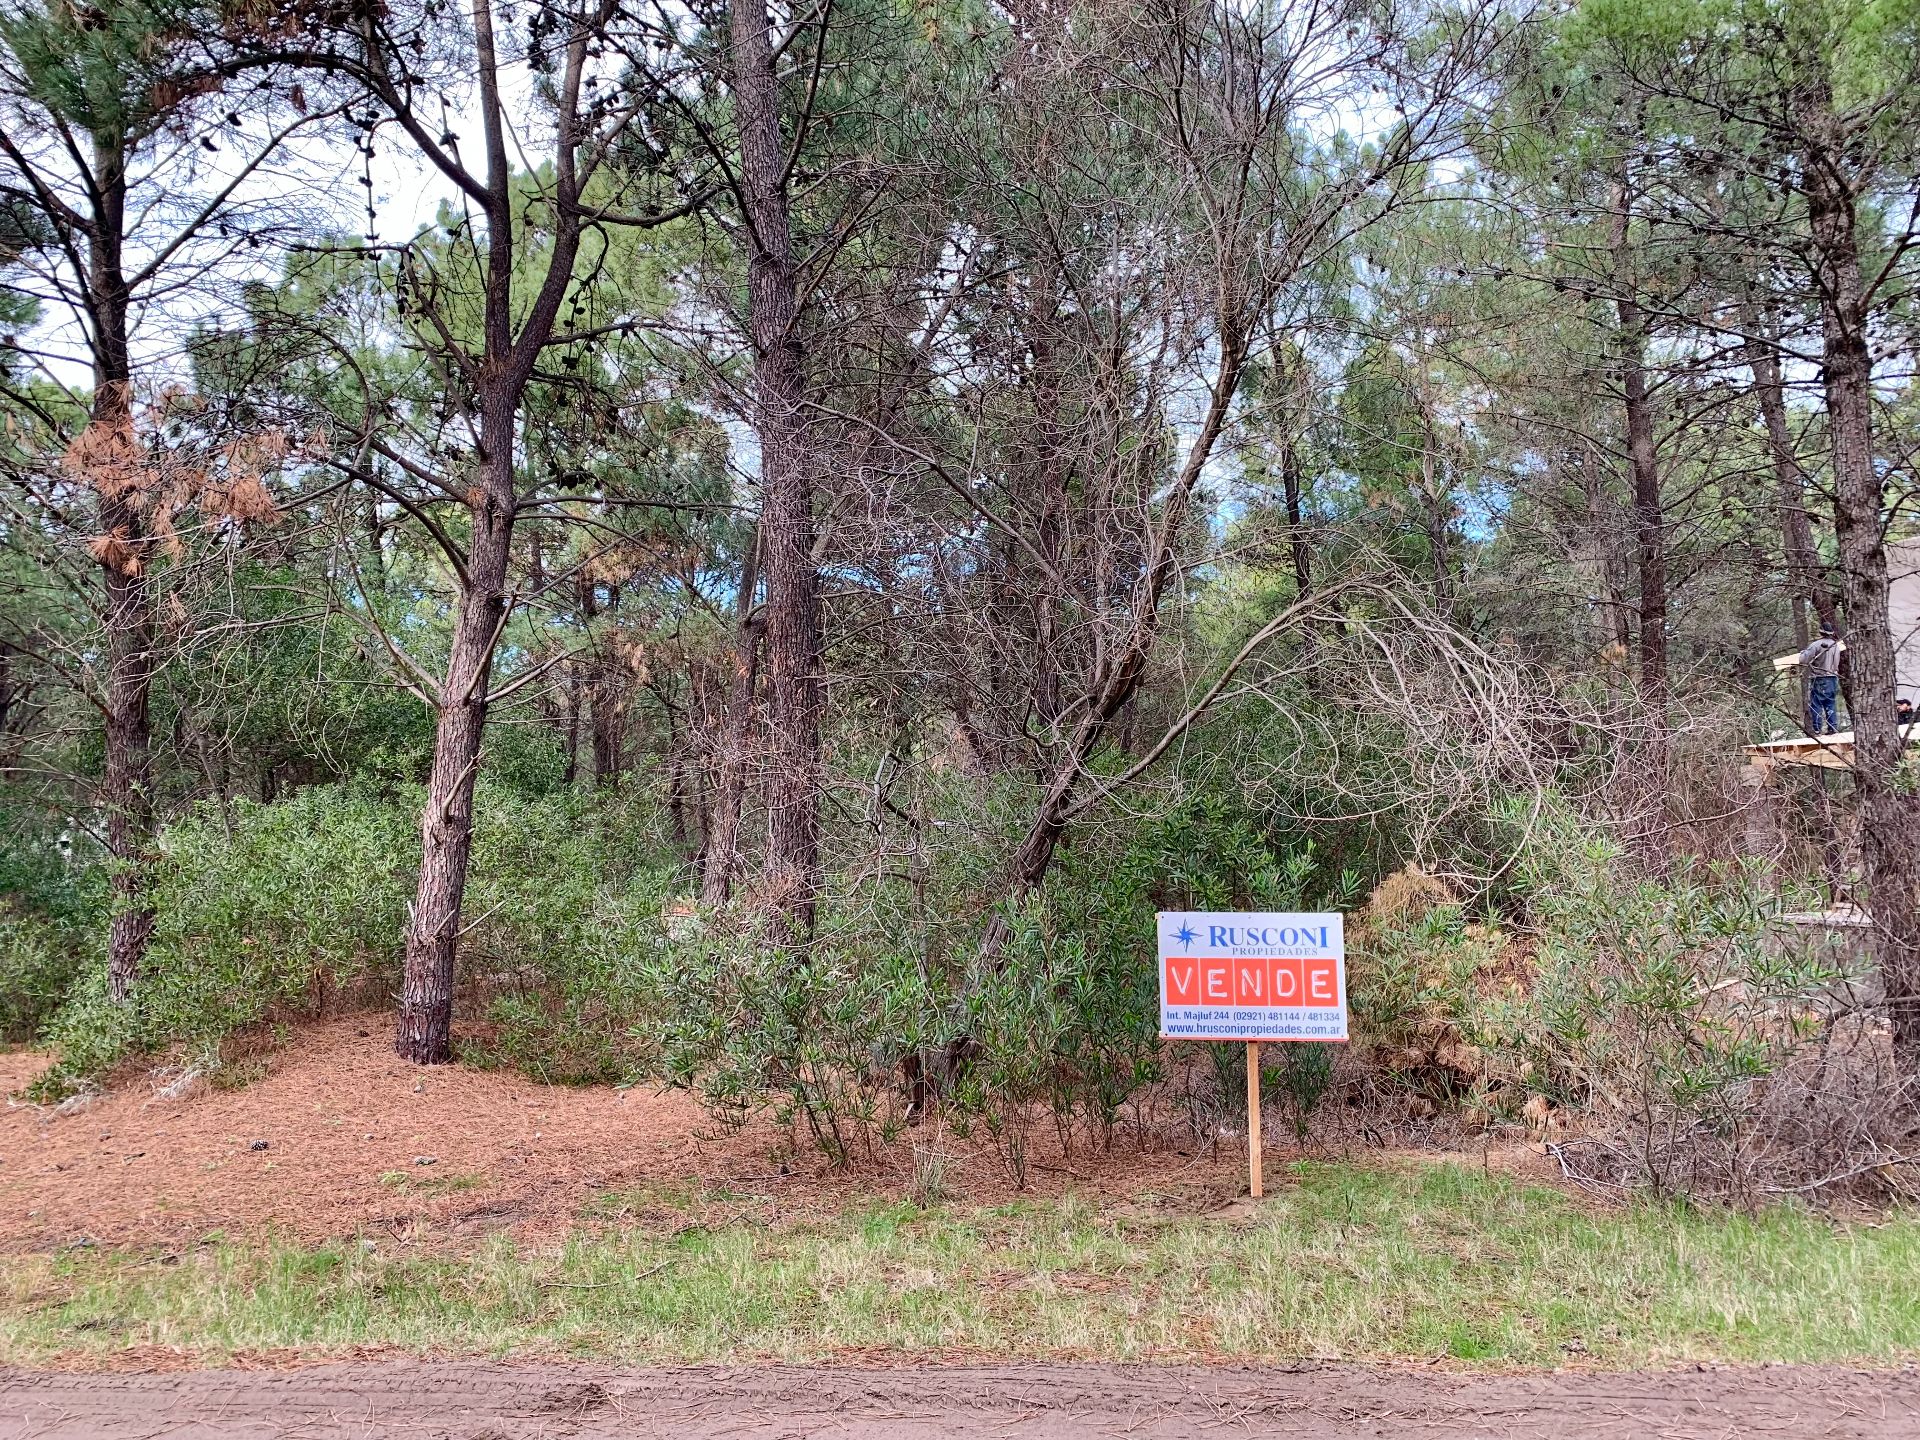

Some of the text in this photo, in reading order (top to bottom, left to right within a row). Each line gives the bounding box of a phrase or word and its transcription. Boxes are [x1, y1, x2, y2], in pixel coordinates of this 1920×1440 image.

[1208, 925, 1330, 948] RUSCONI
[1232, 947, 1318, 956] PROPIEDADES
[1171, 966, 1332, 999] VENDE
[1167, 1012, 1181, 1020] Int.
[1184, 1011, 1212, 1021] Majluf
[1214, 1012, 1229, 1020] 244
[1233, 1012, 1266, 1021] (02921)
[1302, 1013, 1306, 1021] /
[1308, 1013, 1340, 1021] 481334
[1168, 1023, 1340, 1035] www.hrusconipropiedades.com.ar
